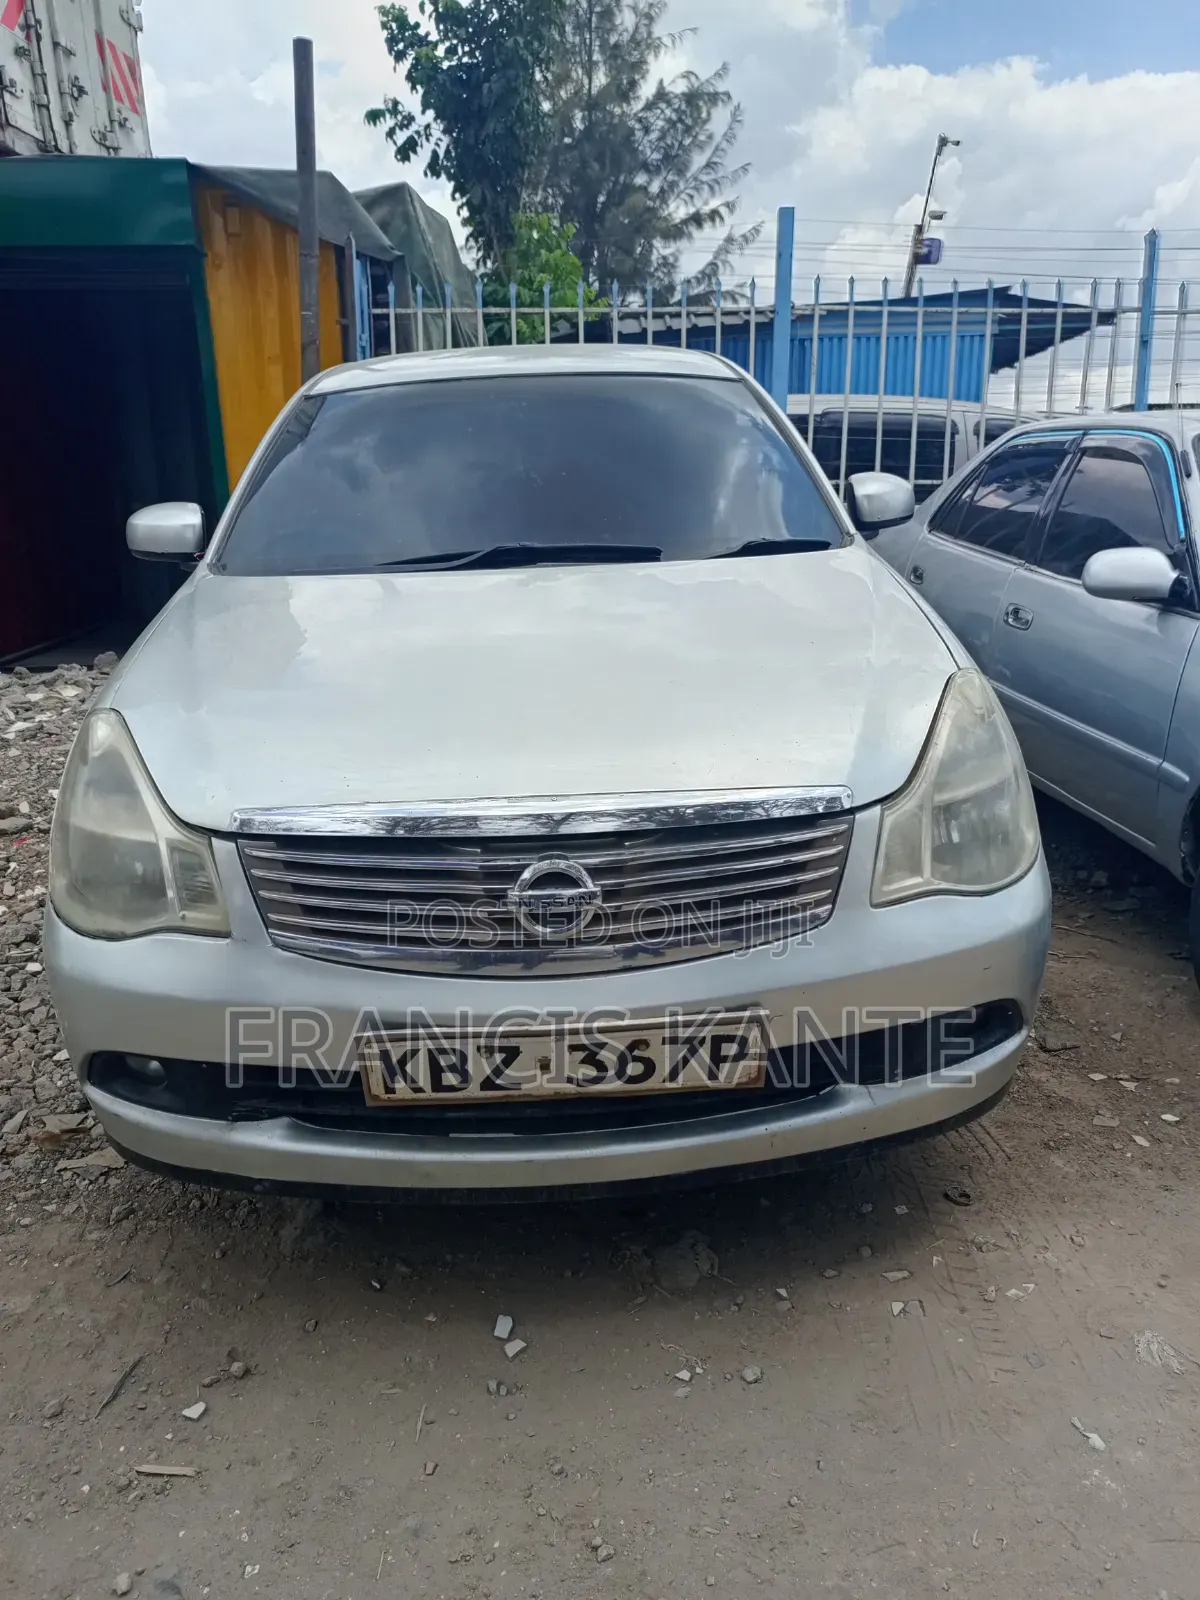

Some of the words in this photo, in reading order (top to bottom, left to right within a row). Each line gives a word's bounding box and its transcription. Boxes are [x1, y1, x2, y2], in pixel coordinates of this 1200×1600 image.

[518, 894, 592, 908] NISSAN
[379, 1044, 523, 1095] KBZ
[566, 1033, 749, 1088] 367P
